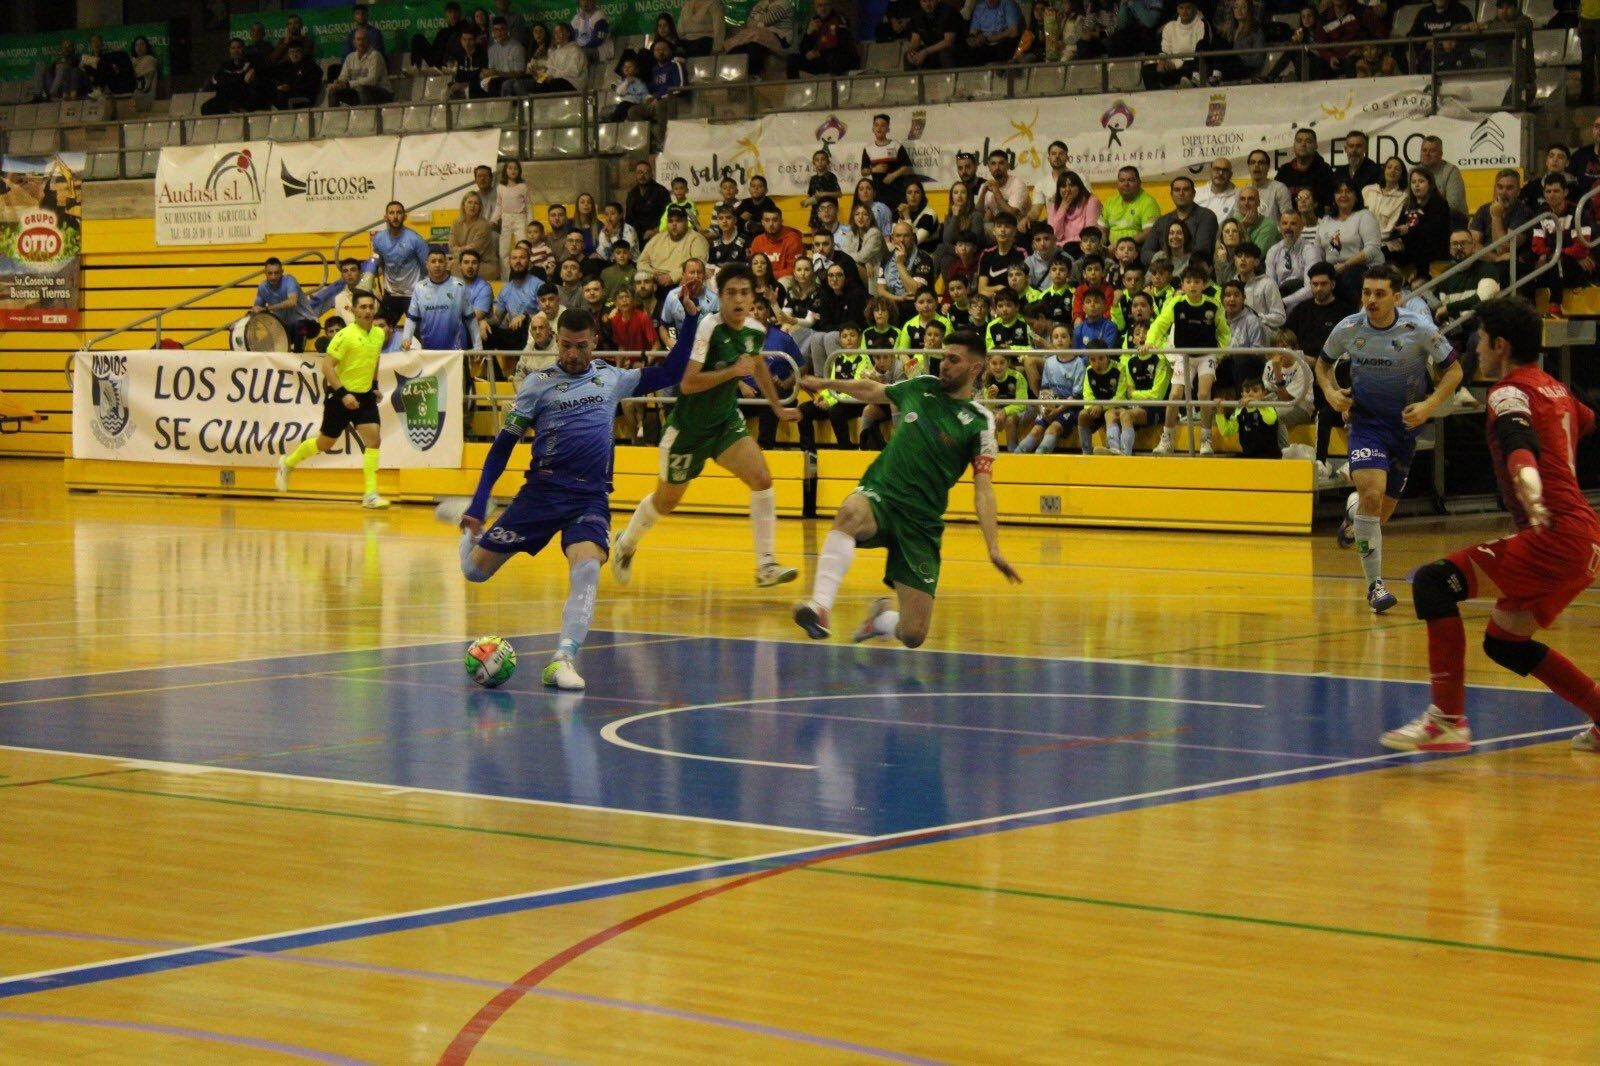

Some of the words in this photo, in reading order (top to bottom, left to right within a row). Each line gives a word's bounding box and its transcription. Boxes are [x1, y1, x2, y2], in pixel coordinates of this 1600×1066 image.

[158, 182, 217, 203] Audasa
[305, 171, 368, 197] fircosa
[24, 213, 55, 226] GRUPO
[21, 234, 58, 254] OTTO
[10, 287, 40, 299] Buenas
[42, 287, 71, 299] Tierras
[92, 354, 128, 377] INDIOS
[154, 365, 216, 402] LOS
[226, 361, 321, 405] SUEÑ
[154, 416, 191, 451] SE
